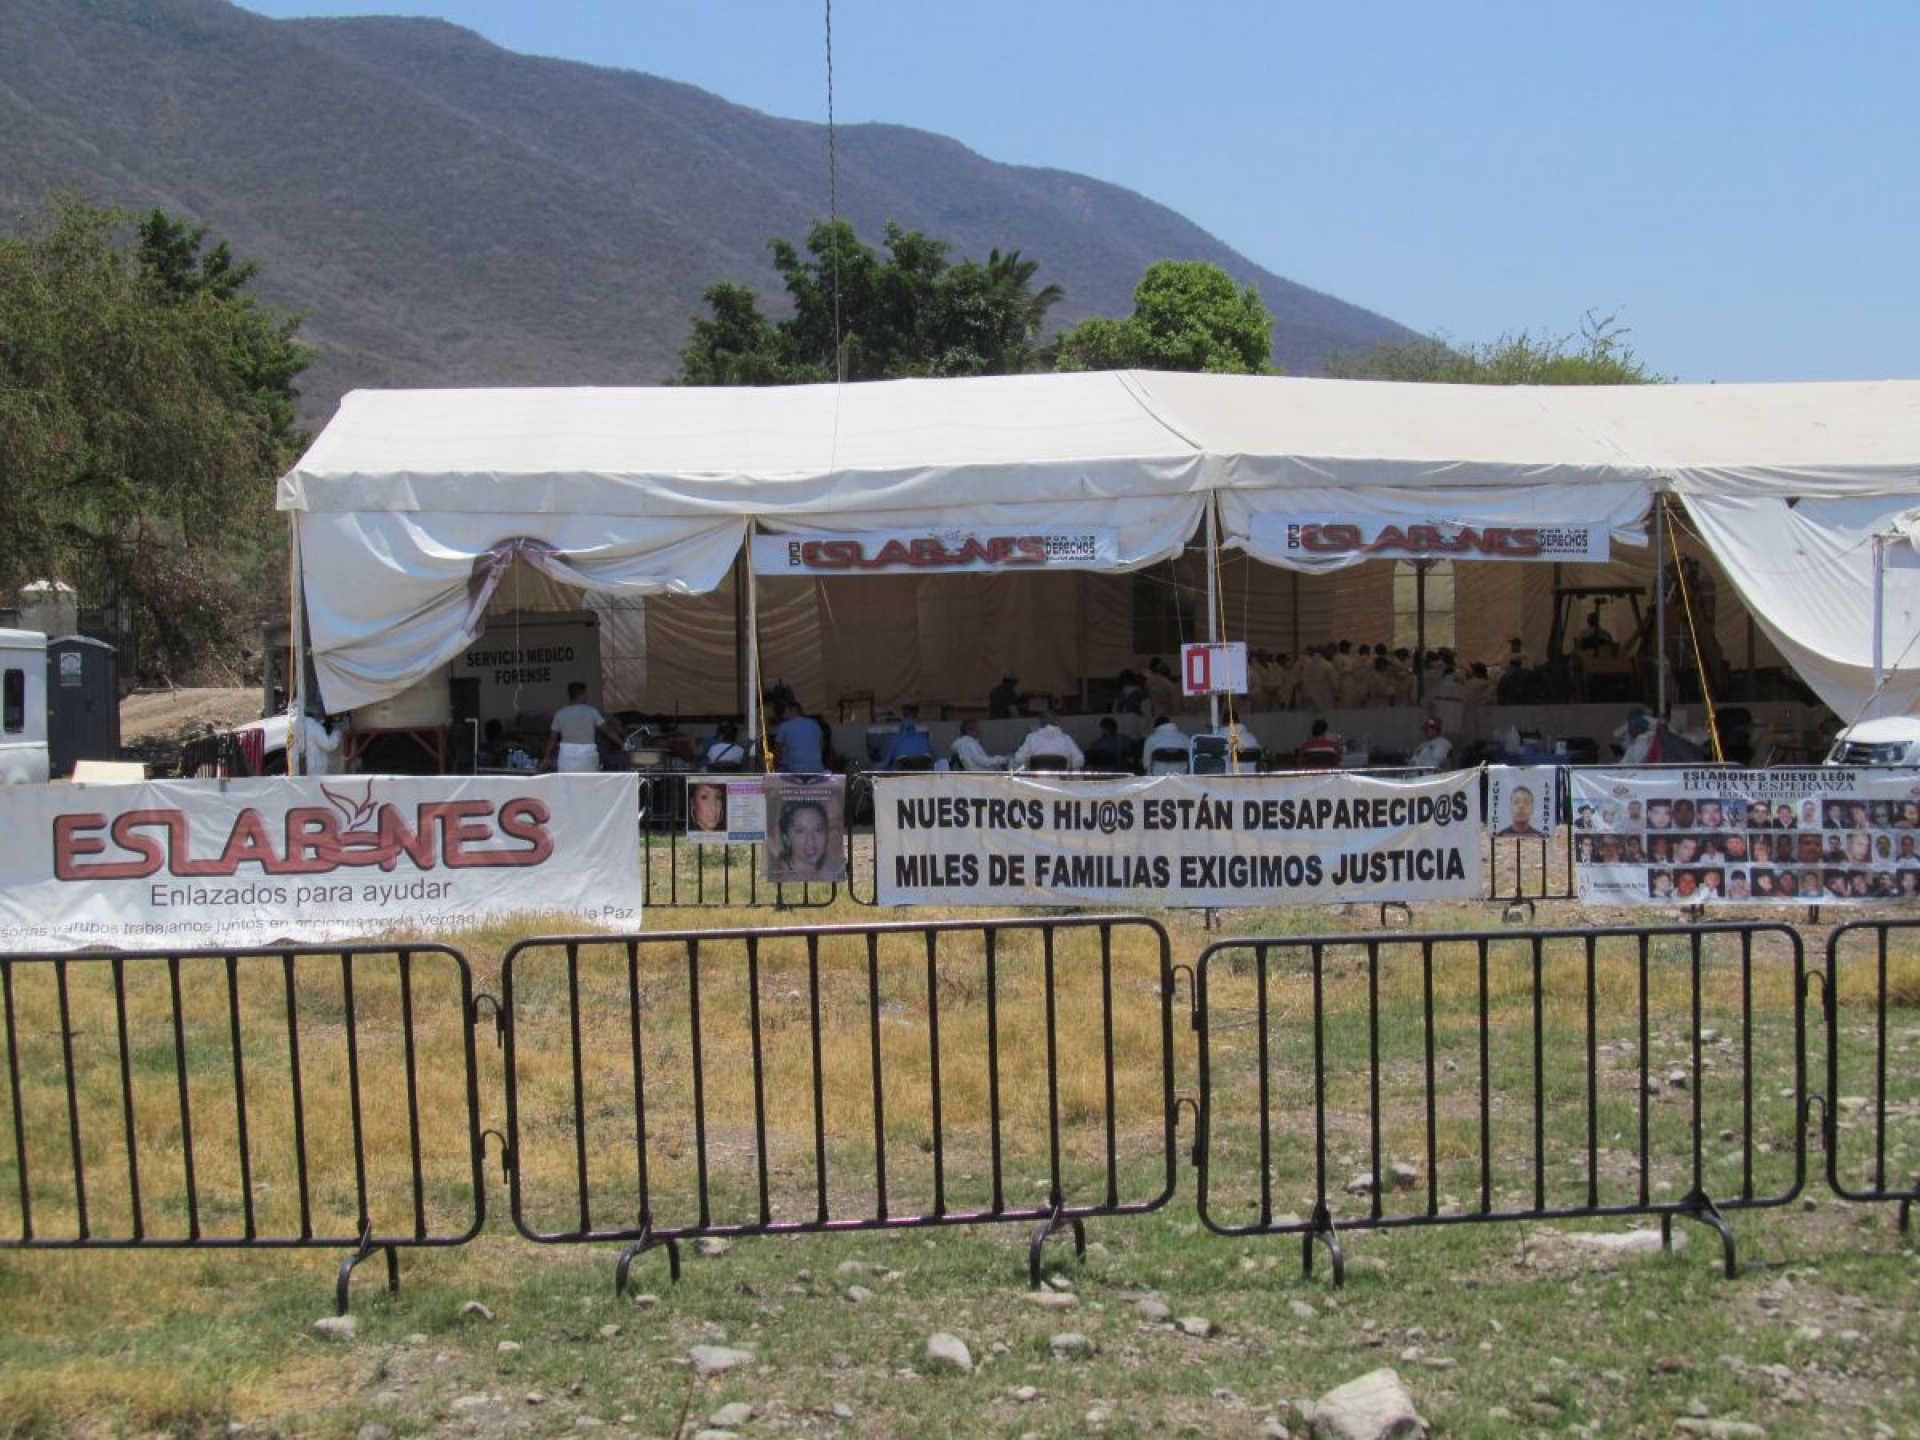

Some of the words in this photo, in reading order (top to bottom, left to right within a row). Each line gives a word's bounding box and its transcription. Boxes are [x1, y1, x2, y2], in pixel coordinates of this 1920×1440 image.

[1046, 541, 1095, 554] DERECHOS
[1540, 534, 1588, 547] DERECHOS
[467, 650, 522, 667] SERVICIO
[527, 647, 574, 663] MEDICO
[496, 667, 551, 685] FORENSE
[1682, 772, 1767, 782] ESLABONES
[1770, 772, 1817, 782] NUEVO
[1684, 781, 1737, 791] LUCHA
[1759, 781, 1856, 791] ESPERANZA
[896, 797, 1044, 830] NUESTROS
[1053, 800, 1134, 835] HIJ@S
[1143, 793, 1233, 830] ESTÁN
[1243, 791, 1468, 830] DESAPARECID@S
[895, 854, 978, 888] MILES
[989, 855, 1025, 887] DE
[1035, 855, 1170, 888] FAMILIAS
[1180, 854, 1323, 888] EXIGIMOS
[1332, 847, 1466, 886] JUSTICIA
[151, 884, 287, 906] Enlazados
[296, 882, 353, 908] para
[362, 878, 453, 906] ayudar
[124, 919, 212, 937] trabajamos
[216, 918, 264, 935] juntos
[603, 904, 634, 919] Paz
